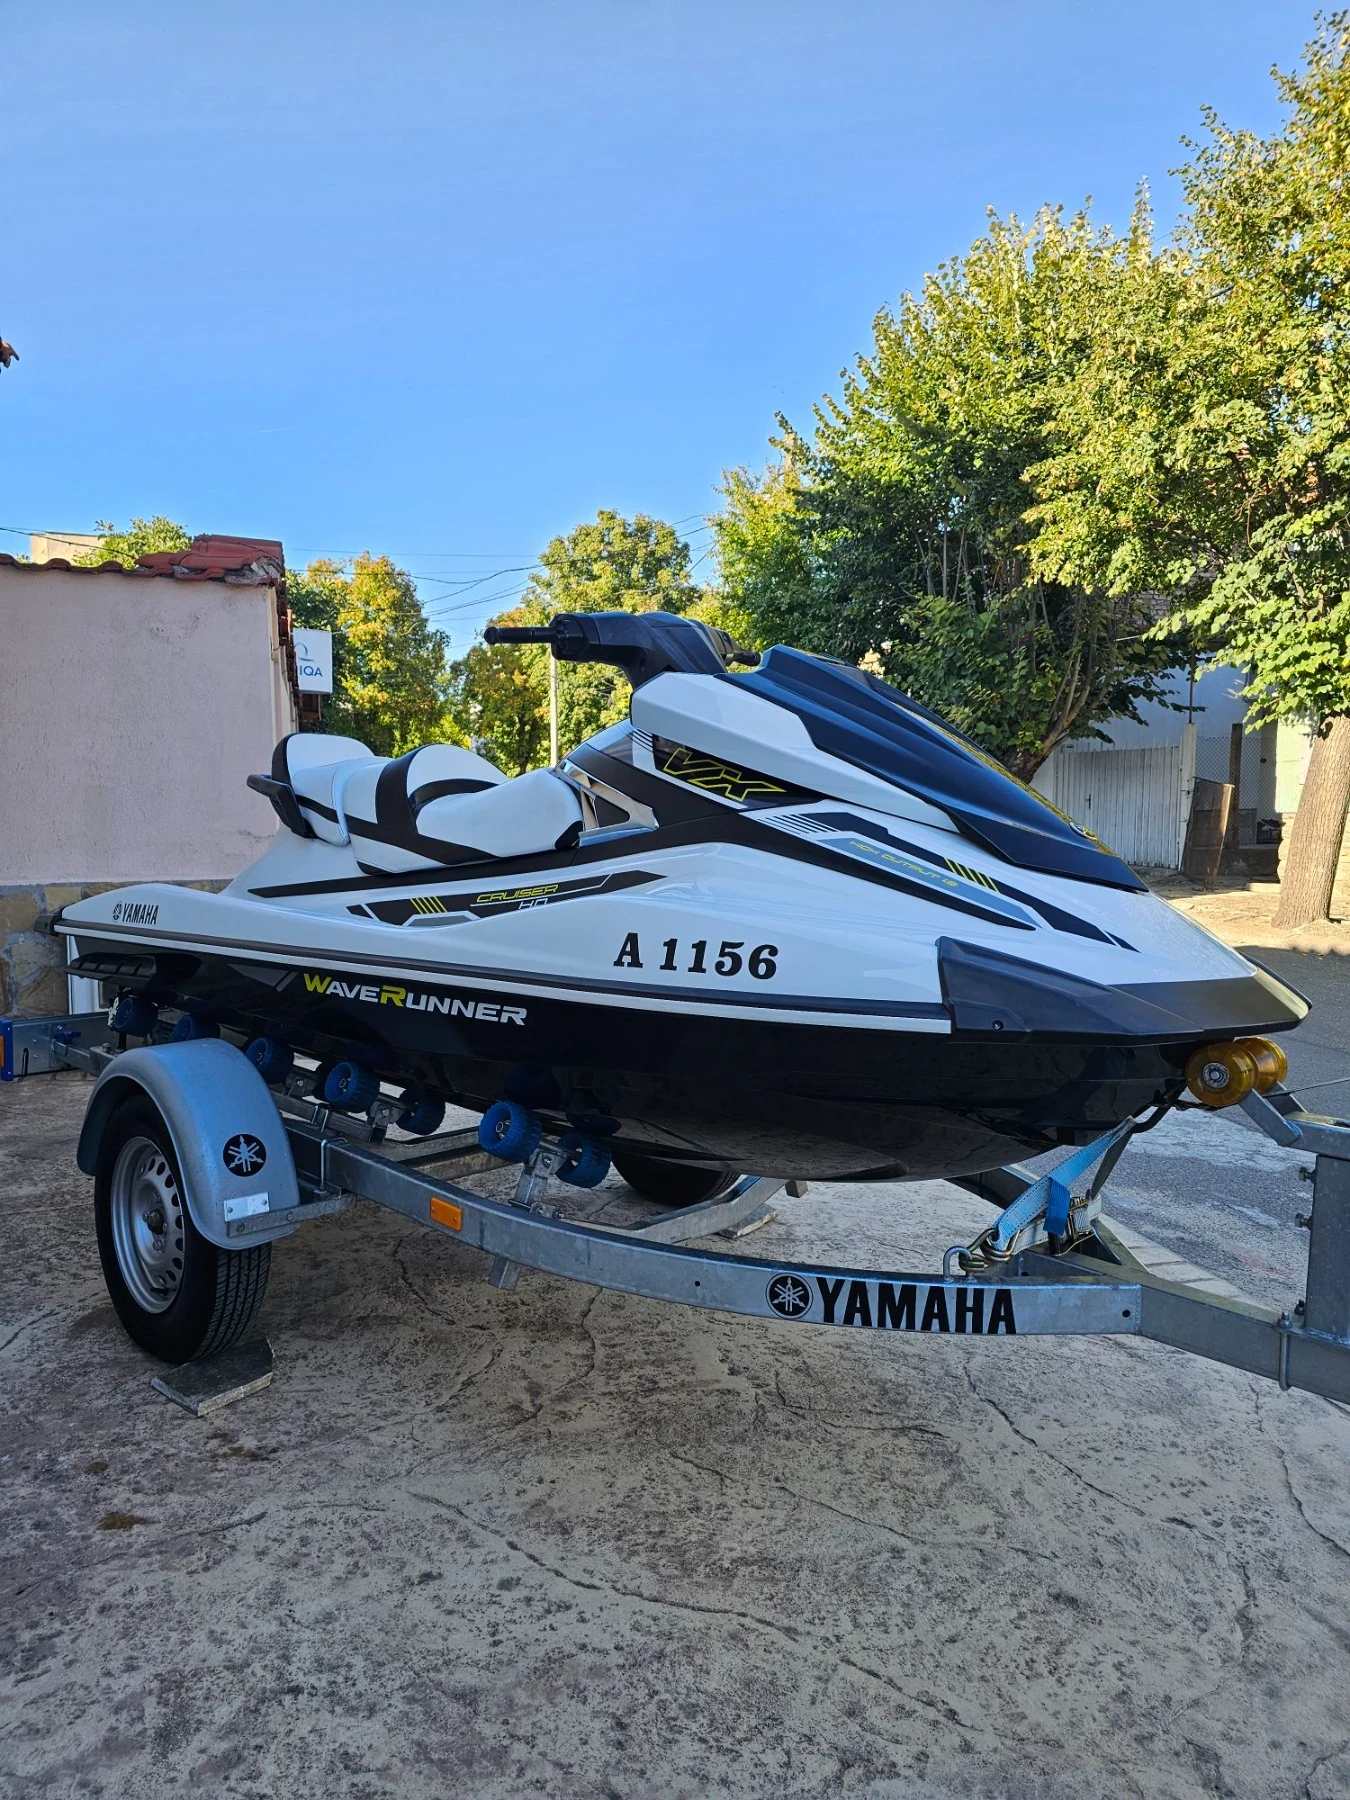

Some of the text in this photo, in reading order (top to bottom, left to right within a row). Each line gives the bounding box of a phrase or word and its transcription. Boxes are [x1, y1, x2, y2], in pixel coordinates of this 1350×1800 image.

[299, 665, 323, 677] IQA
[476, 884, 559, 903] CRUISER
[122, 903, 159, 925] YAMAHA
[613, 932, 779, 980] A 1156
[815, 1277, 1017, 1335] YAMAHA
